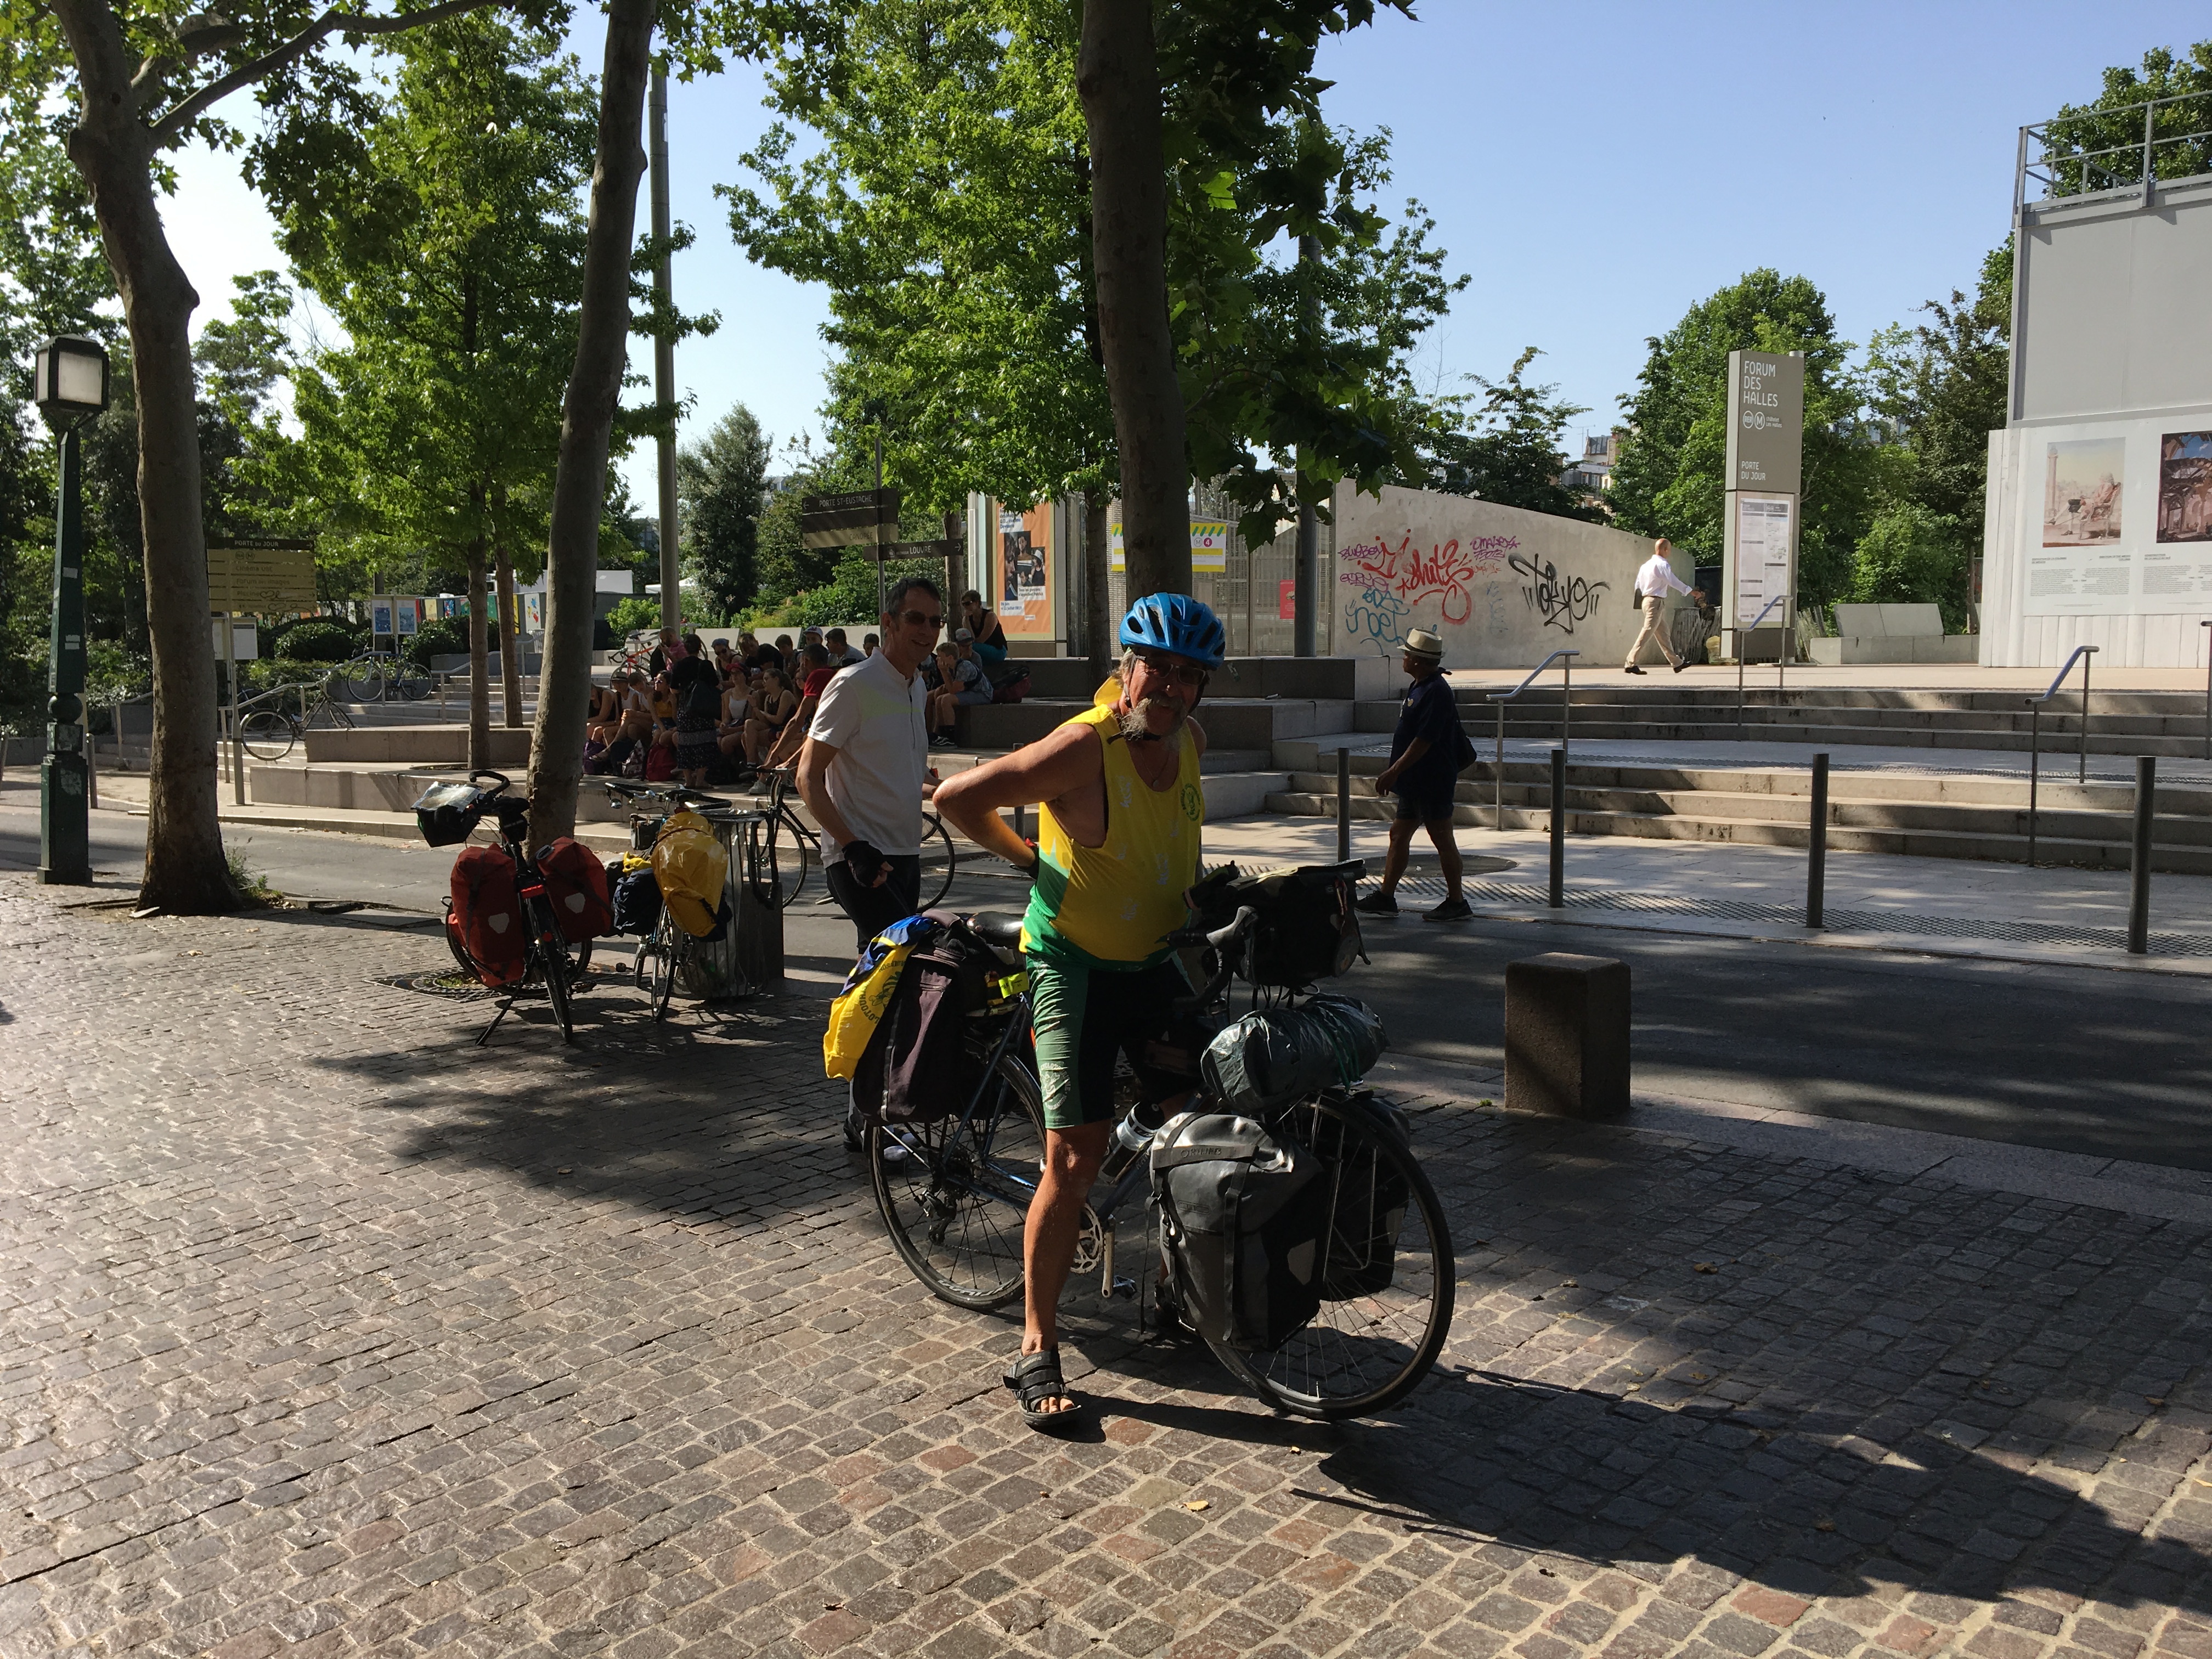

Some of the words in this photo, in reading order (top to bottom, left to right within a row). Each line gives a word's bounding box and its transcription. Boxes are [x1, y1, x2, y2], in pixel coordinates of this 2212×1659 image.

[1744, 360, 1776, 377] FORUM
[1744, 375, 1761, 391] DES
[1743, 391, 1778, 407] HALLES
[1757, 416, 1763, 426] M
[1741, 461, 1759, 470] PORTE
[1741, 471, 1750, 479] DU
[1751, 472, 1766, 481] JOUR
[819, 499, 836, 507] PORTE
[837, 494, 873, 505] ST-EUSTACHE
[910, 545, 932, 555] LOUVRE
